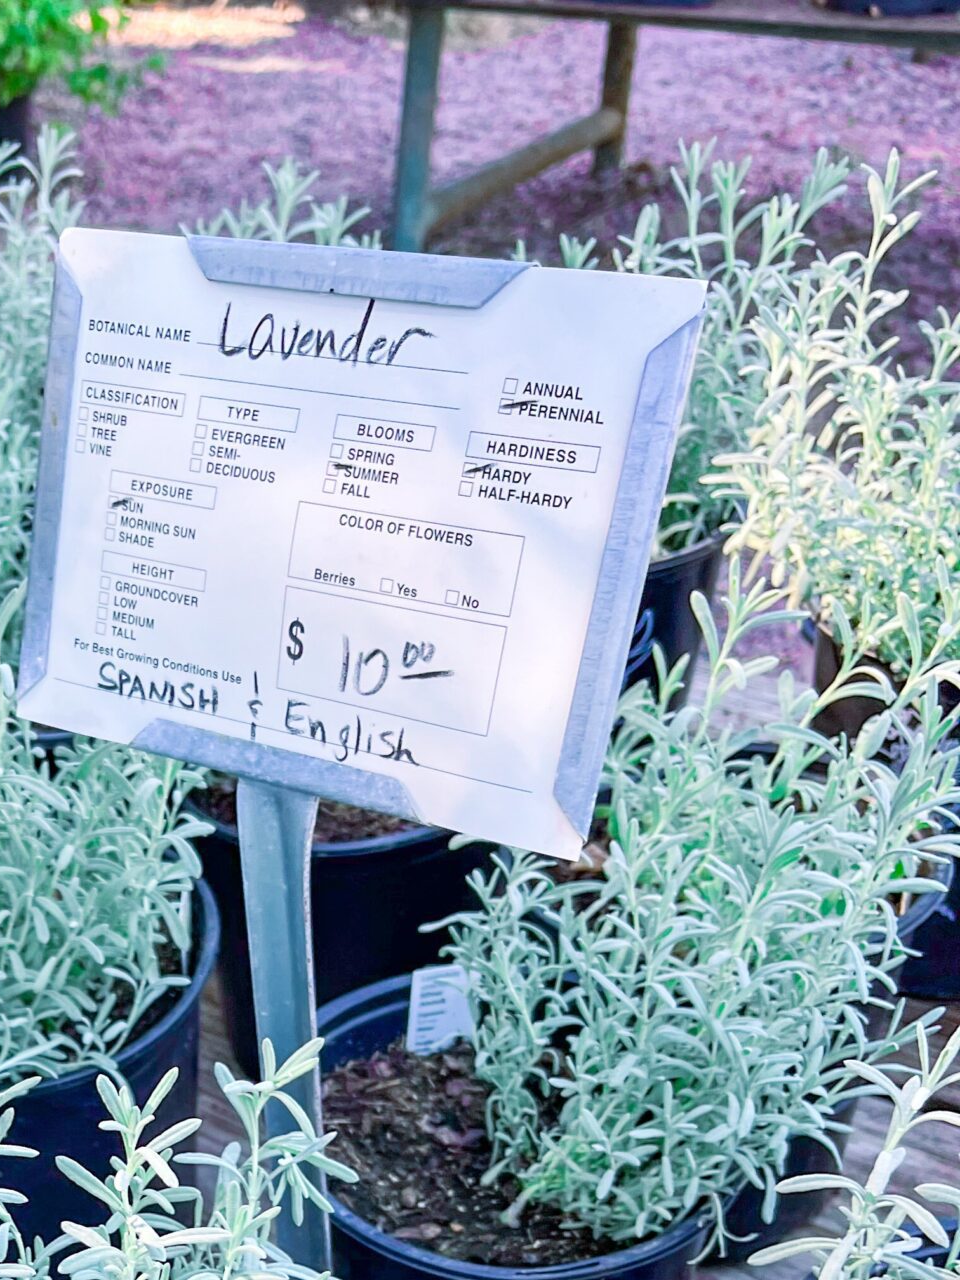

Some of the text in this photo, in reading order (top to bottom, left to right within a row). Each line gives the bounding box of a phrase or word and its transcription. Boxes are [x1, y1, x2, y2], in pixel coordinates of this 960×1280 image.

[88, 298, 436, 367] BOTANICAL NAME Lavender
[85, 352, 172, 374] COMMON NAME
[86, 387, 179, 410] CLASSIFICATION
[522, 381, 583, 401] ANNUAL
[92, 410, 127, 426] SHRUB
[227, 406, 260, 422] TYPE
[518, 402, 604, 425] PERENNIAL
[91, 427, 117, 441] TREE
[211, 429, 286, 450] EVERGREEN
[357, 423, 415, 443] BLOOMS
[89, 443, 112, 457] VINE
[208, 446, 241, 460] SEMI-
[347, 448, 395, 466] SPRING
[486, 440, 577, 464] HARDINESS
[206, 462, 276, 483] DECIDUOUS
[344, 465, 399, 485] SUMMER
[481, 467, 532, 485] HARDY
[130, 479, 194, 501] EXPOSURE
[340, 483, 371, 499] FALL
[478, 484, 572, 509] HALF-HARDY
[121, 500, 144, 514] SUN
[120, 515, 196, 540] MORNING SUN
[339, 513, 473, 547] COLOR OF FLOWERS
[119, 532, 155, 548] SHADE
[131, 562, 174, 581] HEIGHT
[115, 580, 198, 607] GROUNDCOVER
[314, 568, 479, 609] Berries Yes No
[114, 596, 137, 610] LOW
[112, 611, 155, 629] MEDIUM
[111, 626, 136, 641] TALL
[286, 617, 305, 665] $
[74, 638, 242, 685] For Best Growing Conditions Use
[97, 661, 218, 714] SPANISH
[285, 698, 419, 766] English
